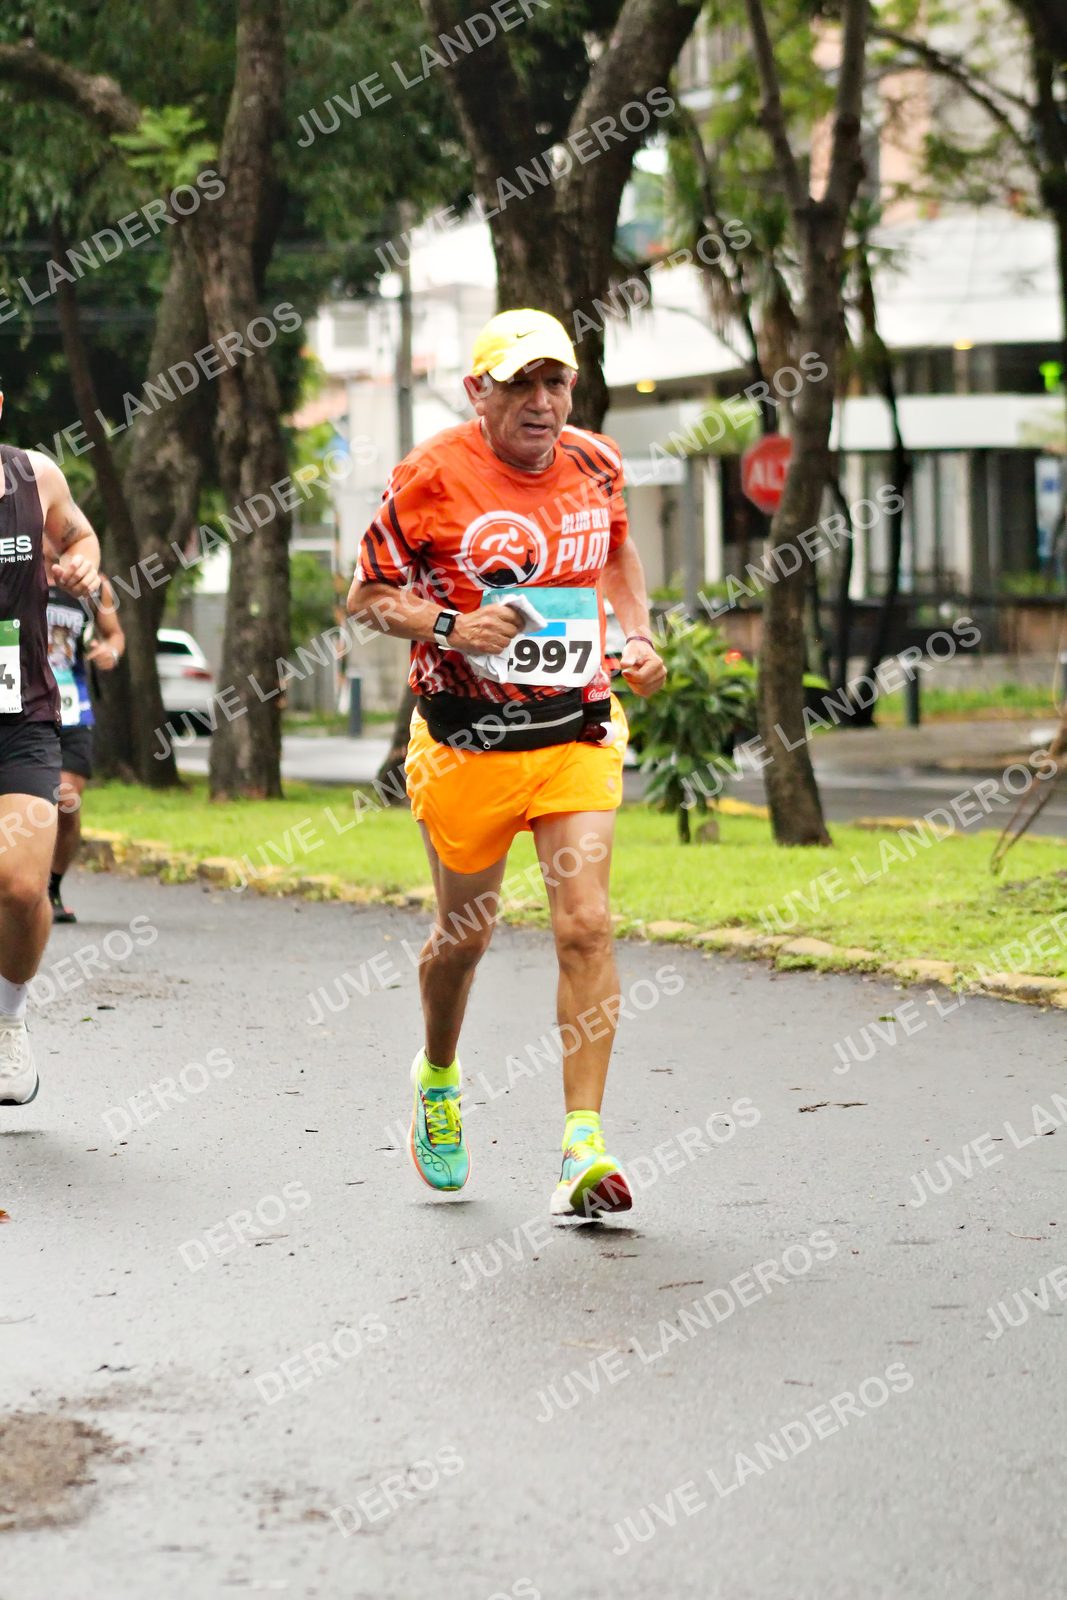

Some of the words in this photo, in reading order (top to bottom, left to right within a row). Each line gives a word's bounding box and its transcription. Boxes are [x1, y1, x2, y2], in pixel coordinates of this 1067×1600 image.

[561, 510, 591, 535] CLUB
[0, 535, 33, 556] ES
[16, 554, 33, 562] RUN
[507, 639, 593, 674] 997
